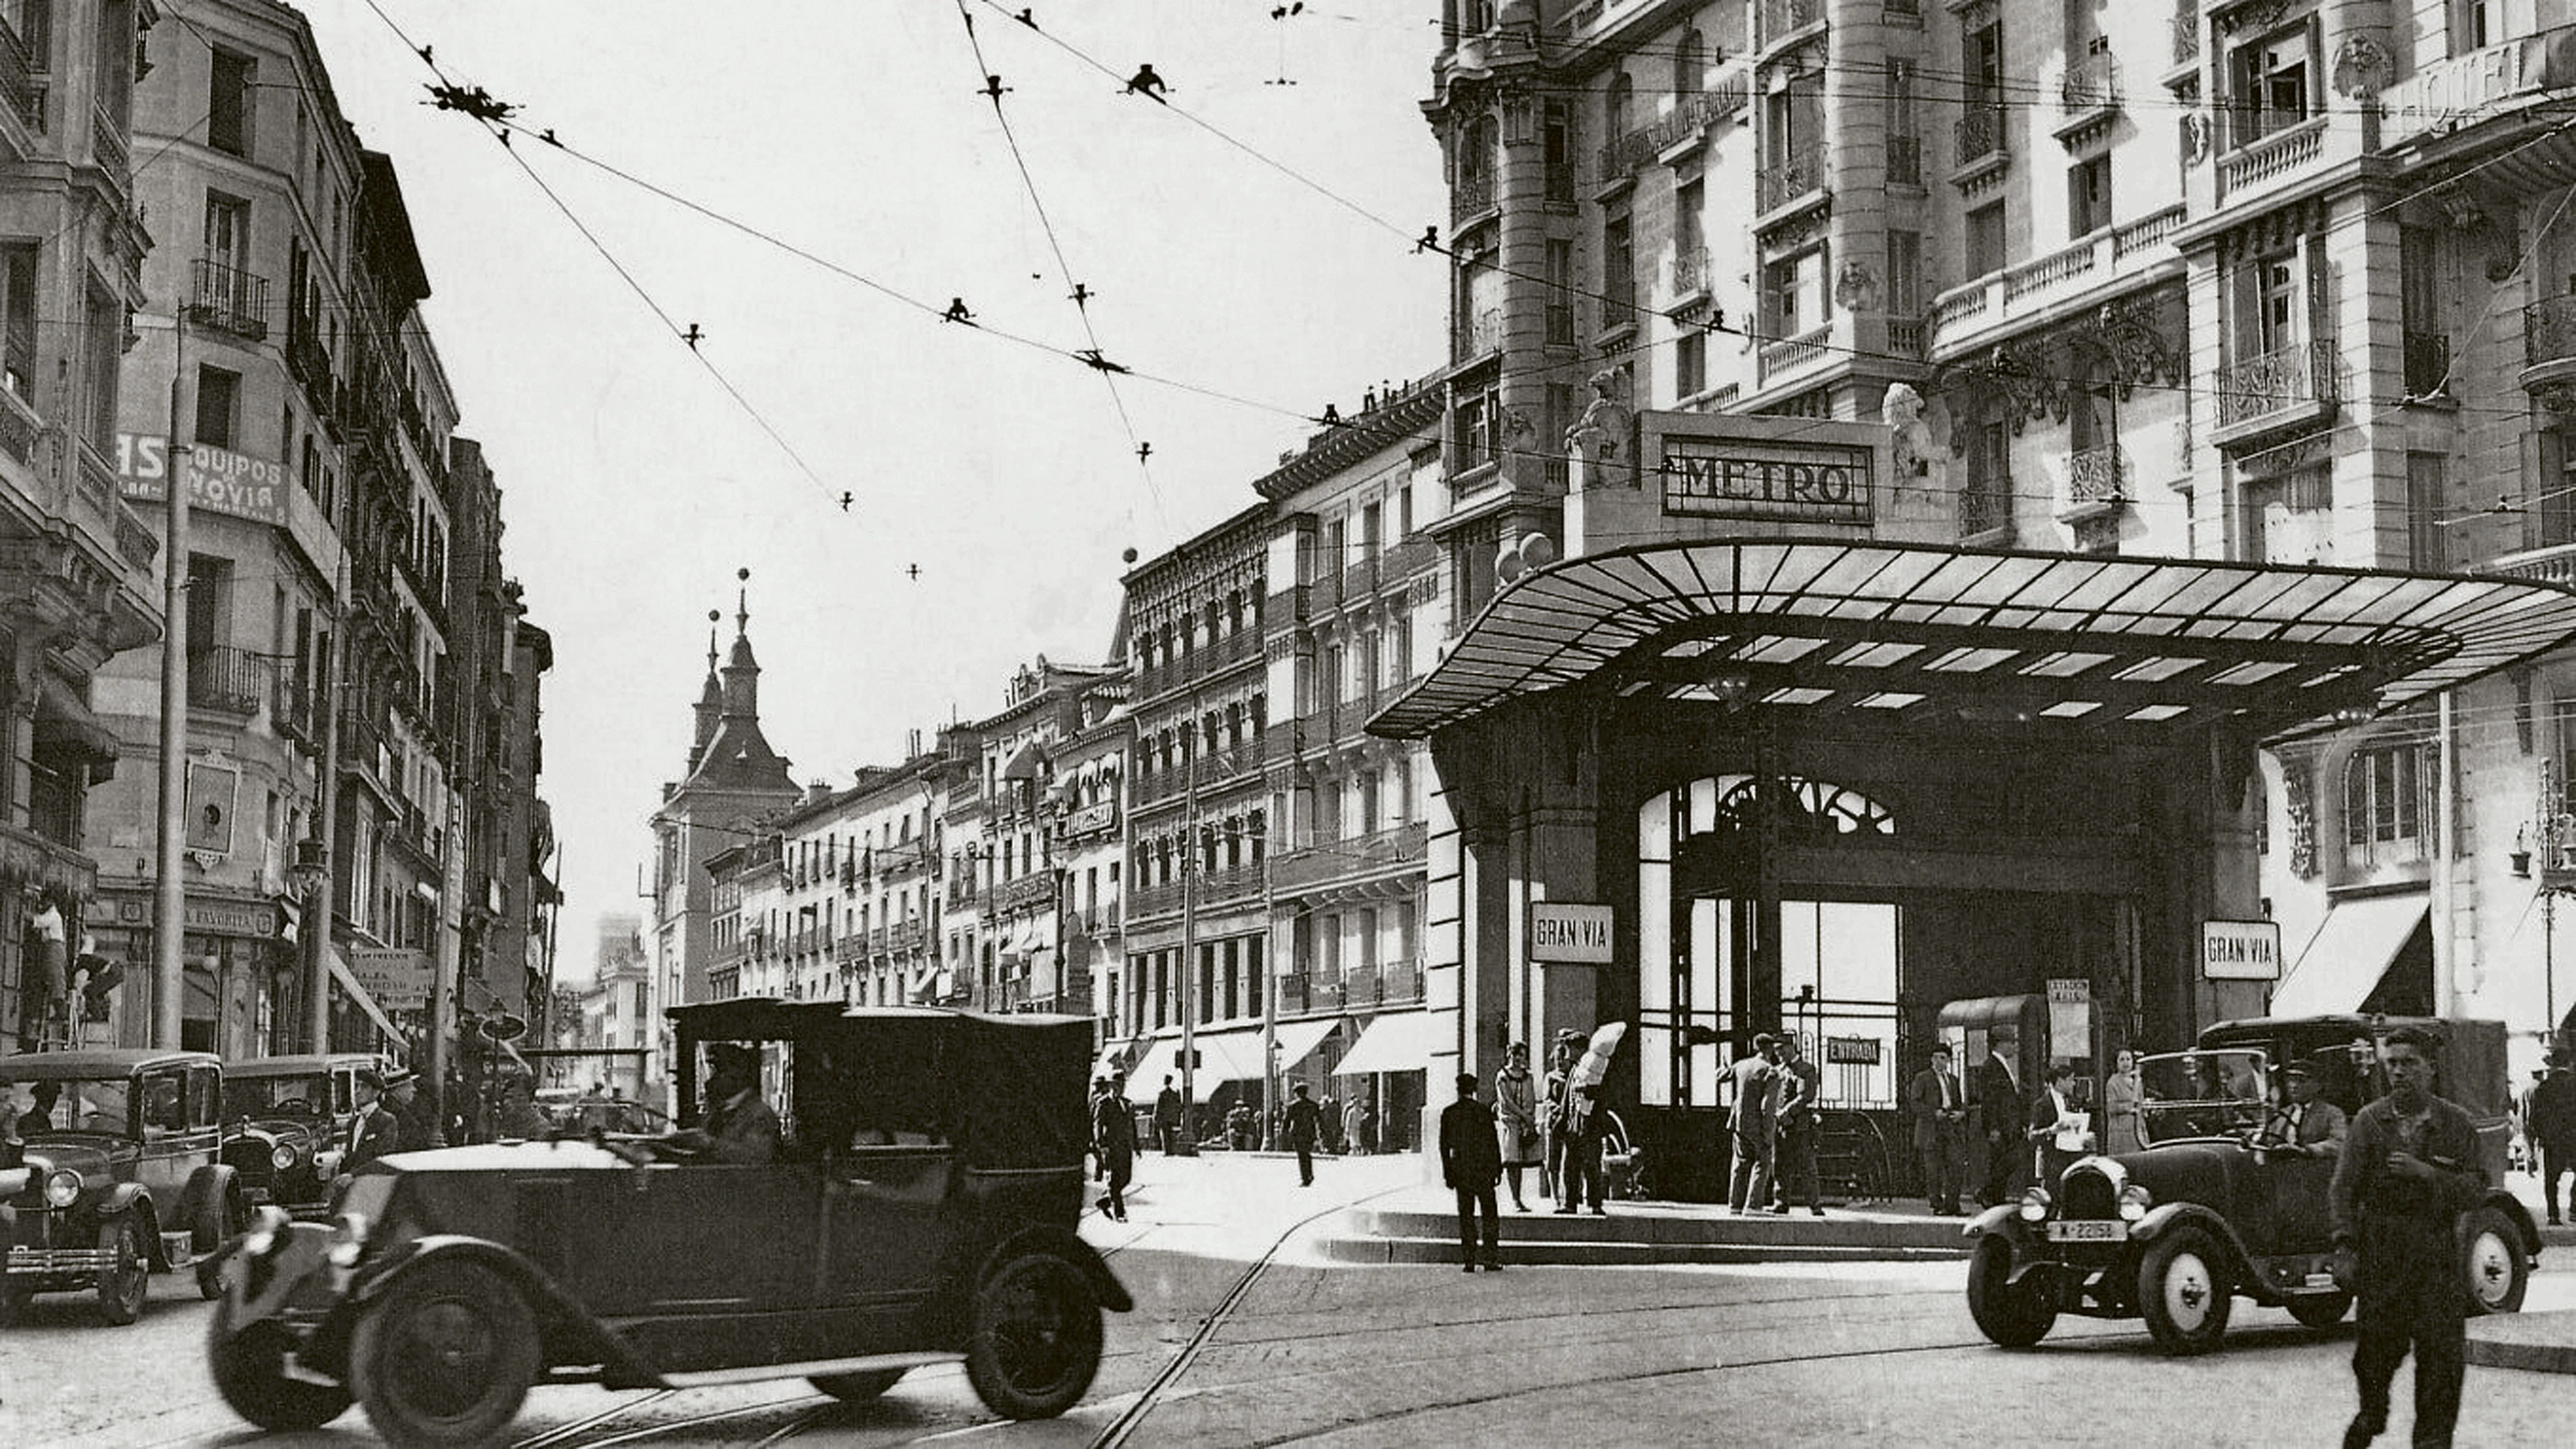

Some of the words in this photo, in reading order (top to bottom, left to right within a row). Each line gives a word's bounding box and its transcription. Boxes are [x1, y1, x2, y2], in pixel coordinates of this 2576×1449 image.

[189, 446, 281, 485] QUIPOS
[1683, 458, 1849, 501] METRO
[188, 468, 274, 506] NOVIA
[196, 911, 250, 927] FAVORITA
[1537, 919, 1576, 947] GRAN
[1583, 919, 1606, 948] VIA
[2208, 937, 2245, 962] GRAN
[2250, 937, 2271, 963] VIA
[1830, 1041, 1878, 1061] ENTRADA
